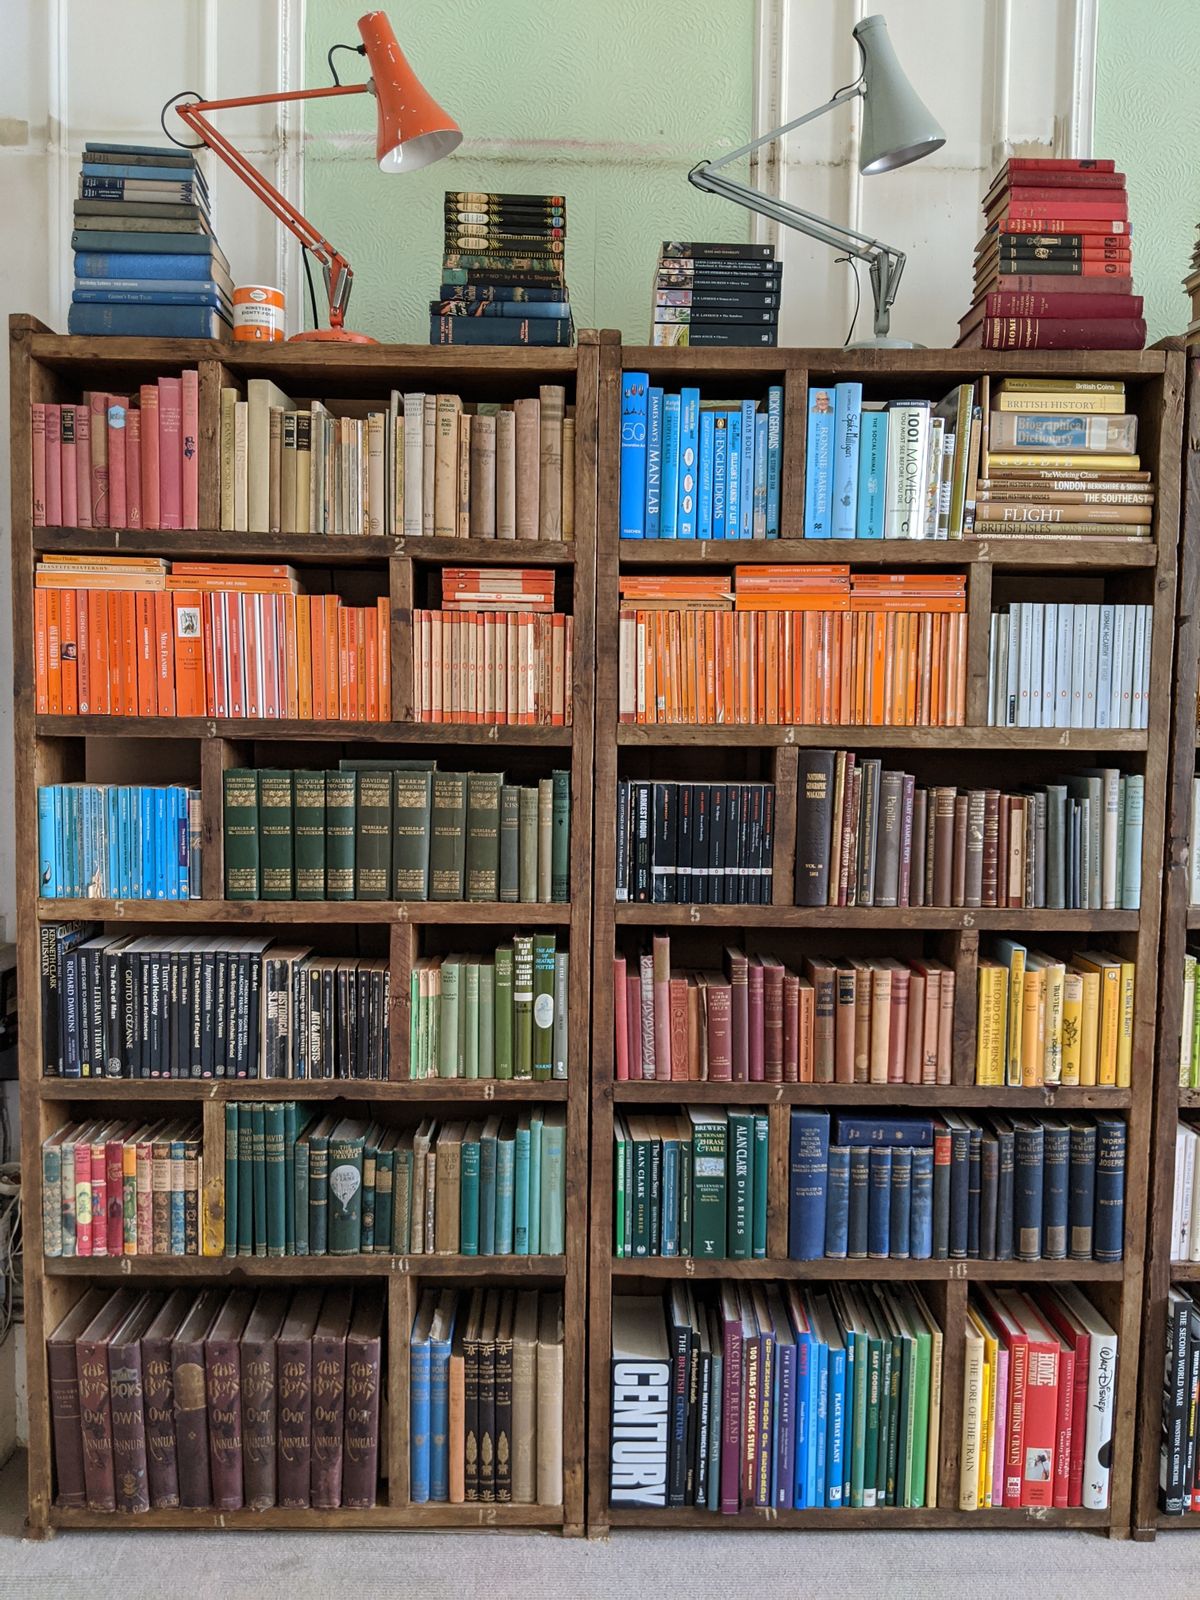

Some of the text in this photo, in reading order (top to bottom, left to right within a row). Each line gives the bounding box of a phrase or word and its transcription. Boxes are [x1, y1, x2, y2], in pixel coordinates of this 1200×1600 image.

[1007, 318, 1017, 346] HOME
[1075, 382, 1096, 390] British
[768, 391, 780, 449] RICKY GERVAIS
[1007, 400, 1096, 410] BRITISH HISTORY
[841, 413, 858, 458] Spike Milligan
[1017, 418, 1087, 433] Biographical
[1017, 429, 1074, 445] Dictionary
[648, 396, 660, 514] JAMES MAY'S MAN LAB
[818, 426, 829, 513] RONNIE BARKER
[904, 412, 920, 504] 1001 MOVIES
[715, 439, 724, 519] ENGLISH IDIOMS
[1054, 481, 1086, 491] LONDON
[1083, 493, 1148, 503] THE SOUTHEAST
[980, 521, 1051, 533] BRITISH ISLES
[1002, 508, 1064, 522] FLIGHT
[115, 532, 120, 548] 1
[394, 537, 405, 555] 2
[701, 540, 706, 558] 1
[977, 542, 989, 561] 2
[1102, 610, 1111, 657] CORMAC McCARTHY
[206, 721, 217, 739] 3
[784, 726, 795, 744] 3
[639, 789, 648, 839] DARKEST HOUR
[884, 795, 897, 832] Papillon
[114, 902, 125, 918] 5
[690, 906, 700, 923] 5
[963, 911, 975, 927] 6
[41, 928, 49, 976] CIVILISATION
[48, 928, 56, 964] KENNETH
[162, 963, 170, 992] Turner
[204, 964, 214, 1011] Impressionism
[66, 960, 75, 1033] RICHARD DAWKINS
[125, 969, 134, 1049] GIOTTO TO CÉZANNE
[151, 985, 159, 1016] Hockney
[267, 990, 278, 1019] SLANG
[94, 986, 103, 1060] LITERARY THEORY
[278, 990, 288, 1037] HISTORICAL
[990, 970, 1002, 1072] THE LORD OF THE RINGS
[311, 1010, 321, 1061] ART & ARTISTS
[484, 1084, 495, 1100] 8
[774, 1085, 785, 1101] 7
[637, 1169, 645, 1198] CLARK
[651, 1181, 659, 1198] Story
[735, 1125, 747, 1235] ALAN CLARK DIARIES
[1037, 1352, 1056, 1386] HOME
[1175, 1310, 1188, 1407] THE SECOND WORLD WAR
[675, 1333, 687, 1442] THE BRITISH CENTURY
[730, 1334, 740, 1444] ANCIENT IRELAND
[871, 1350, 879, 1404] EASY COOKING
[747, 1346, 758, 1460] 100 YEARS OF CLASSIC STEAM
[834, 1393, 842, 1416] PLACE
[966, 1358, 979, 1472] THE LORE OF THE TRAIN
[1010, 1346, 1026, 1464] TRADITIONAL BRITISH CRAFTS
[610, 1363, 670, 1506] CENTURY
[1173, 1419, 1181, 1445] WINSTON
[833, 1439, 841, 1463] PLANT
[1172, 1454, 1180, 1487] CHURCHILL
[478, 1509, 496, 1524] 12
